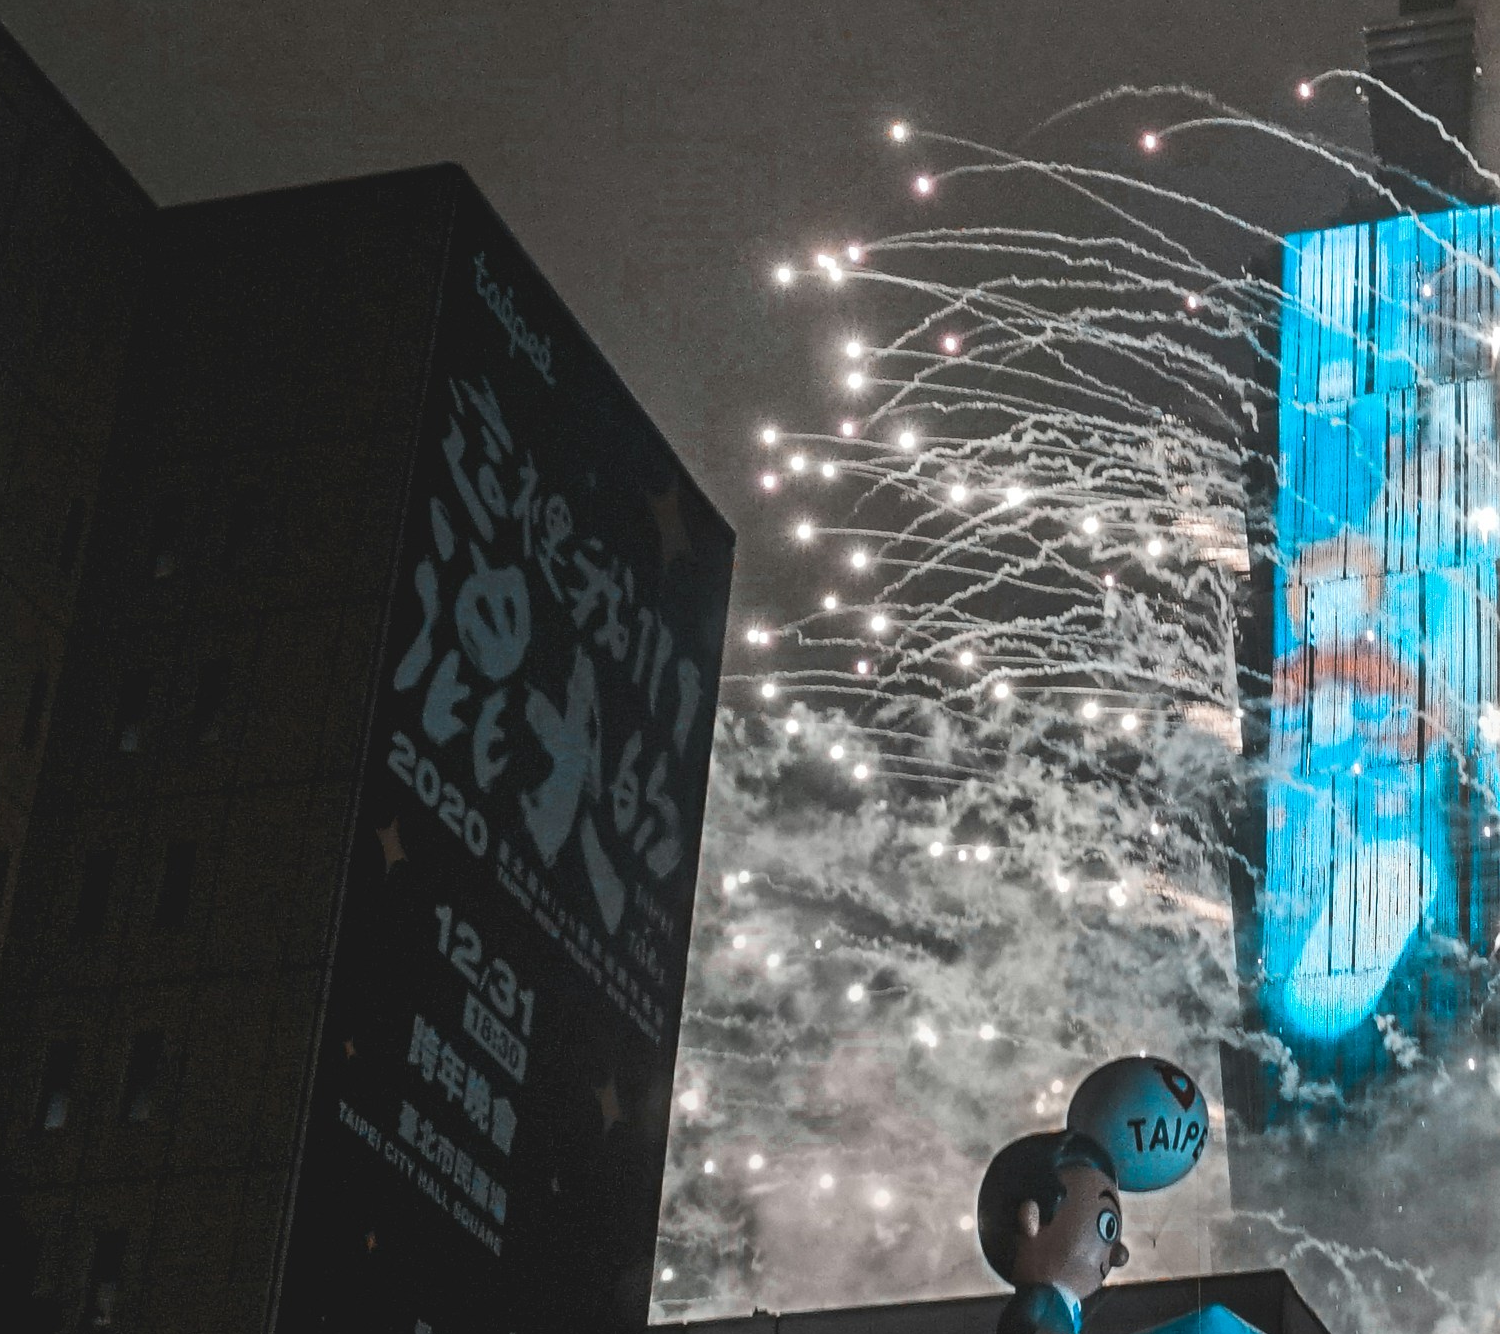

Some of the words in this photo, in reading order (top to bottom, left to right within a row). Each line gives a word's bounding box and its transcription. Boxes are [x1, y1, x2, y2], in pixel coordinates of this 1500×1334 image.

[387, 731, 489, 857] 2020
[436, 905, 535, 1036] 12/31
[407, 1014, 518, 1155] 跨年晚會
[473, 1010, 519, 1071] 18:30
[340, 1101, 381, 1151] TAIPEI
[384, 1141, 415, 1178] CITY
[417, 1170, 449, 1211] HALL
[452, 1200, 503, 1257] SQUARE
